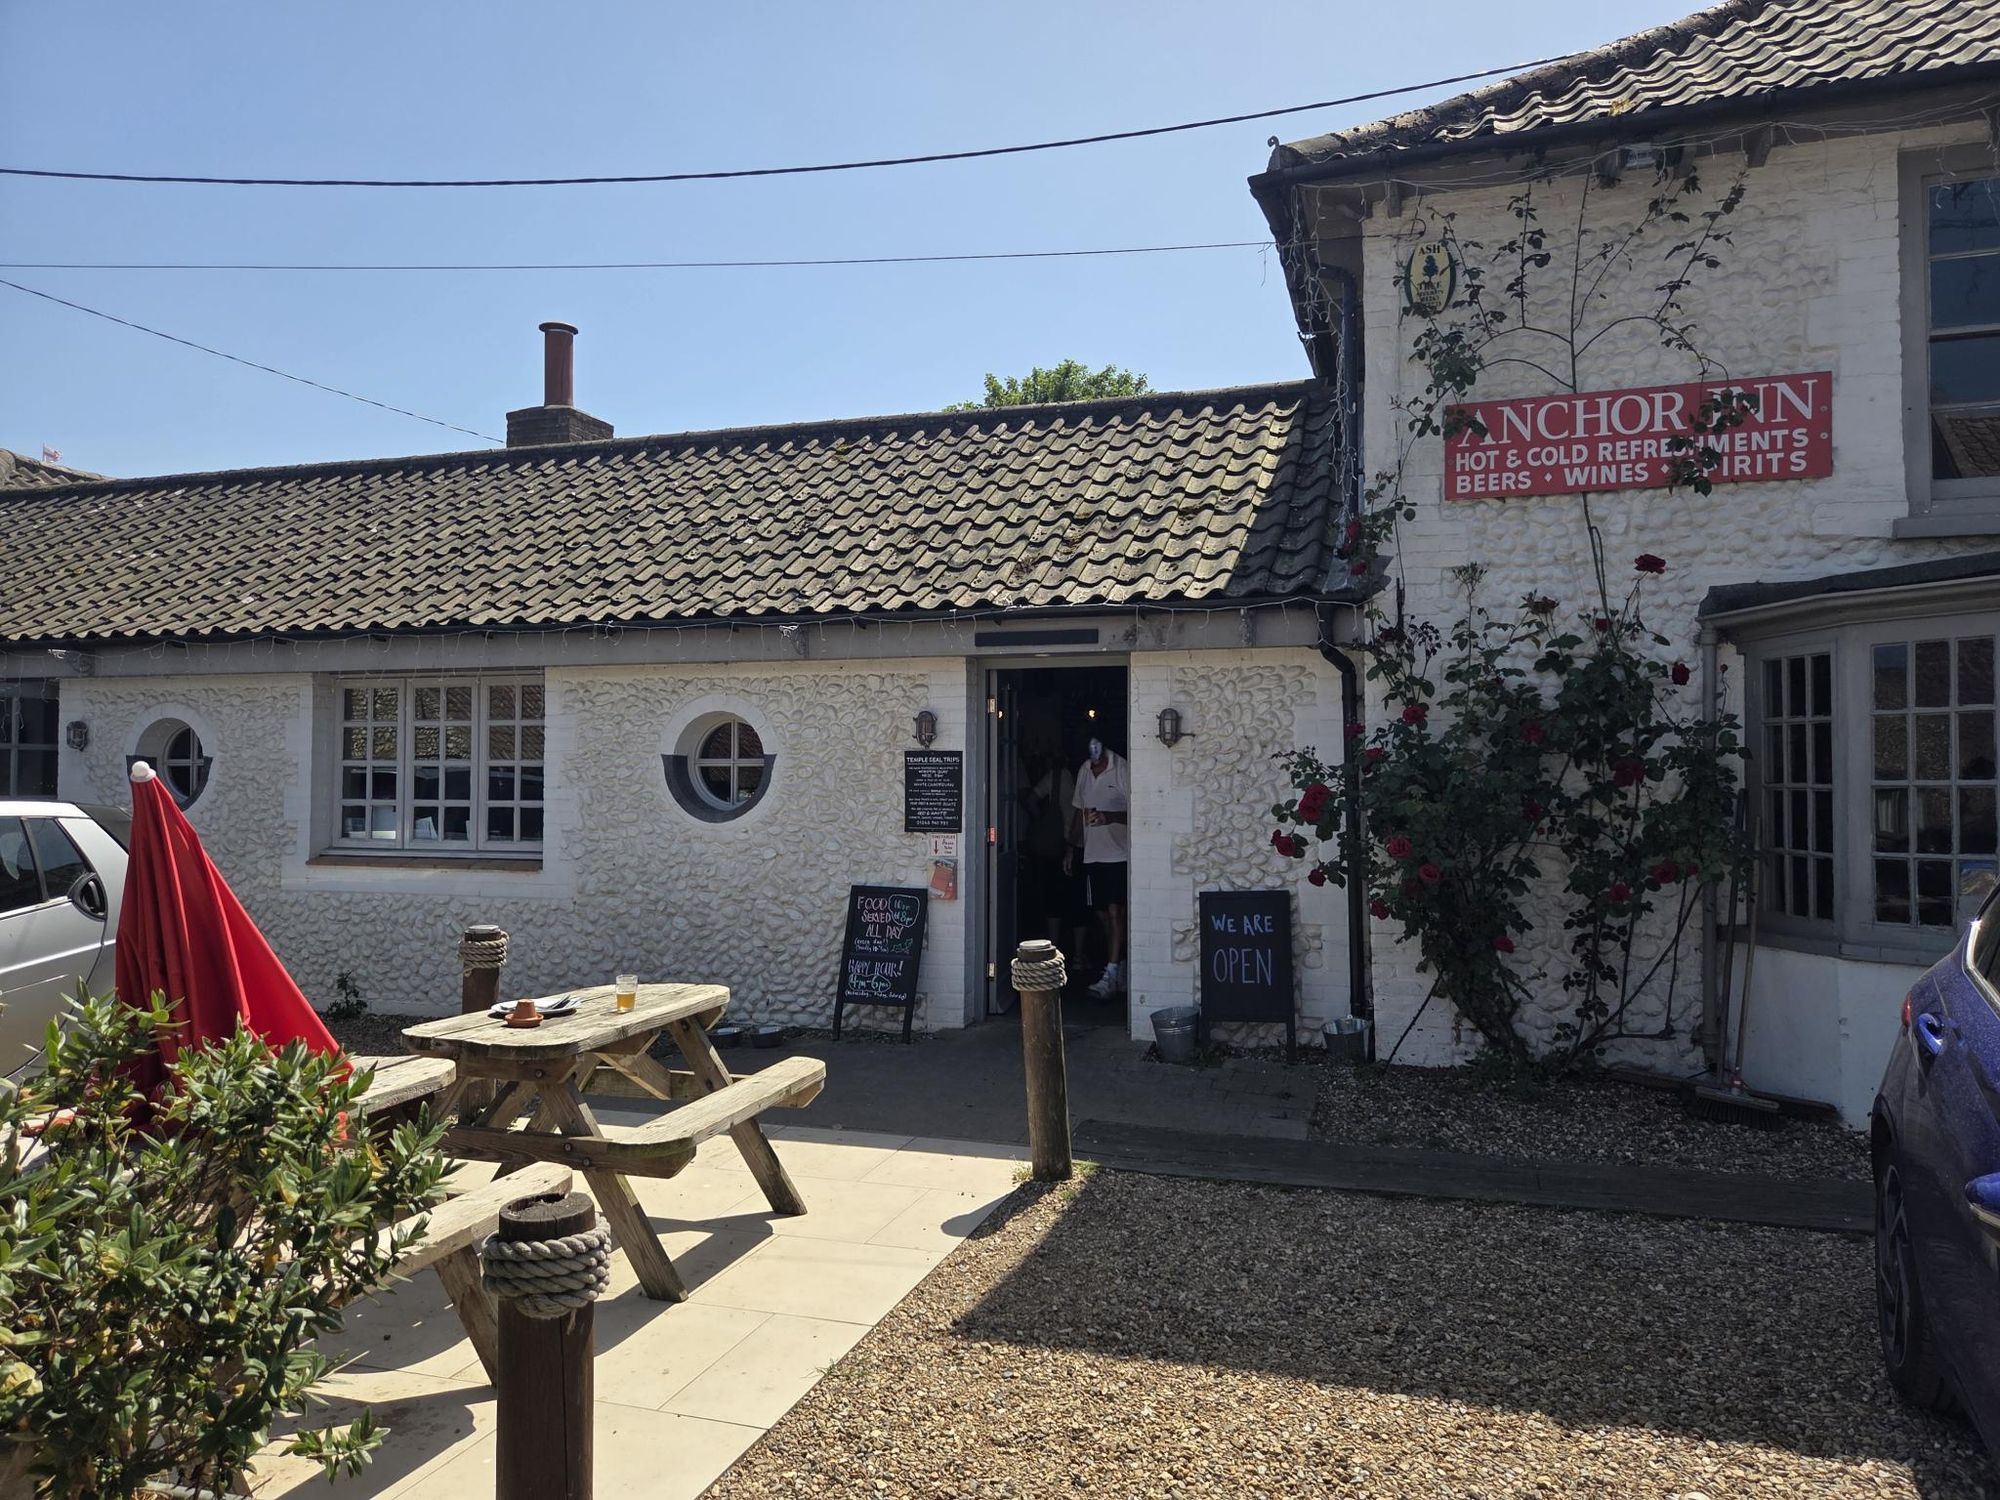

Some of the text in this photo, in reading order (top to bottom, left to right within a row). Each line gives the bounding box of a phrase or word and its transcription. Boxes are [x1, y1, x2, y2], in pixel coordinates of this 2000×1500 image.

[1419, 244, 1441, 256] ASH
[1457, 391, 1688, 448] ANCHOR
[1455, 450, 1500, 472] HOT
[1506, 449, 1522, 468] &
[1526, 441, 1588, 467] COLD
[1455, 470, 1532, 494] BEERS
[1563, 461, 1649, 487] WINES
[857, 896, 888, 910] FOOD
[861, 909, 892, 923] SERVED
[1211, 913, 1275, 937] WE ARE
[865, 924, 904, 939] ALL DAY
[848, 959, 904, 977] HAPPY HOUR!
[1213, 947, 1272, 986] OPEN
